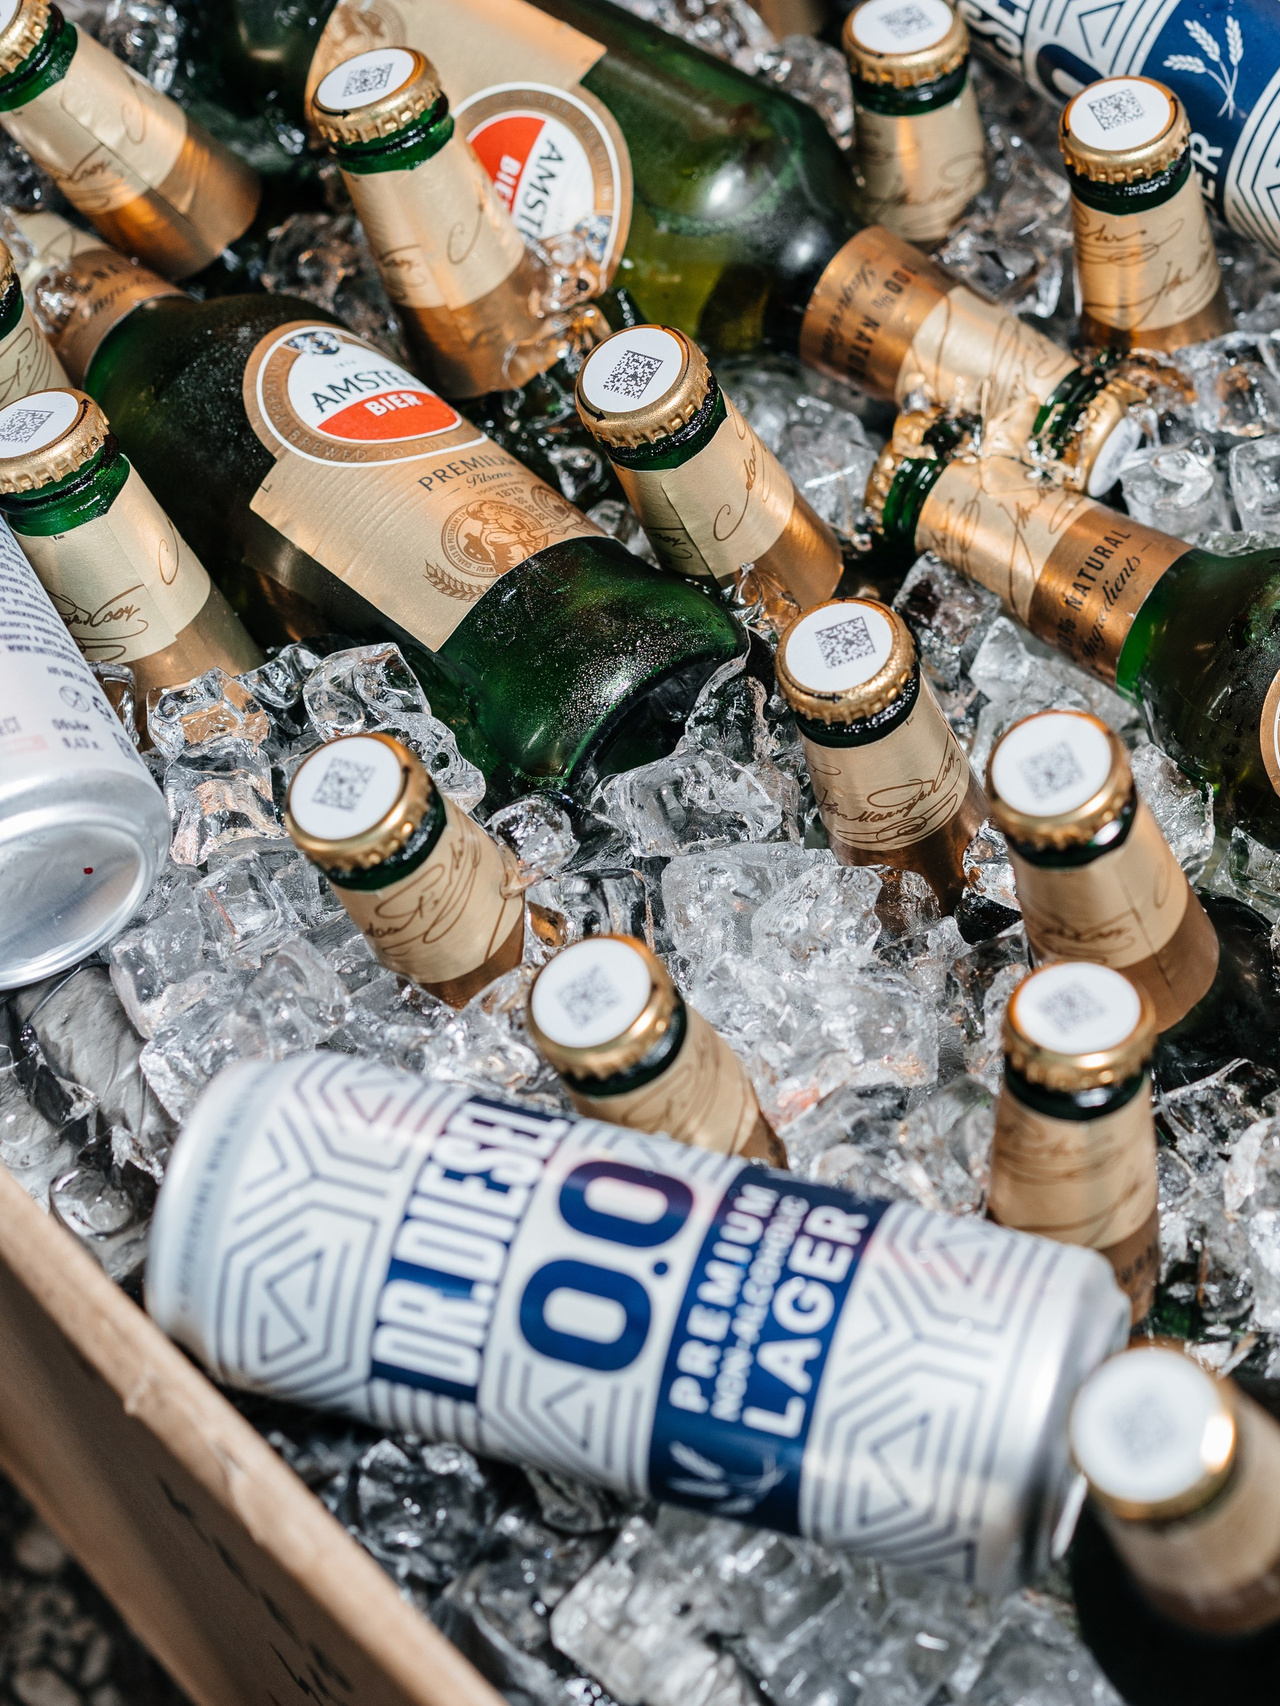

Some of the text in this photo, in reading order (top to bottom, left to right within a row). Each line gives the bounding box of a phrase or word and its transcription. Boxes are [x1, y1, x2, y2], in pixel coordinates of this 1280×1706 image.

[493, 154, 522, 205] BIE
[517, 139, 565, 237] AMST
[364, 391, 424, 417] BIER
[495, 486, 524, 499] 1870
[1065, 529, 1132, 613] NATURAL
[518, 1159, 696, 1373] 0.0
[668, 1183, 781, 1416] PREMIUM
[741, 1204, 871, 1439] LAGER
